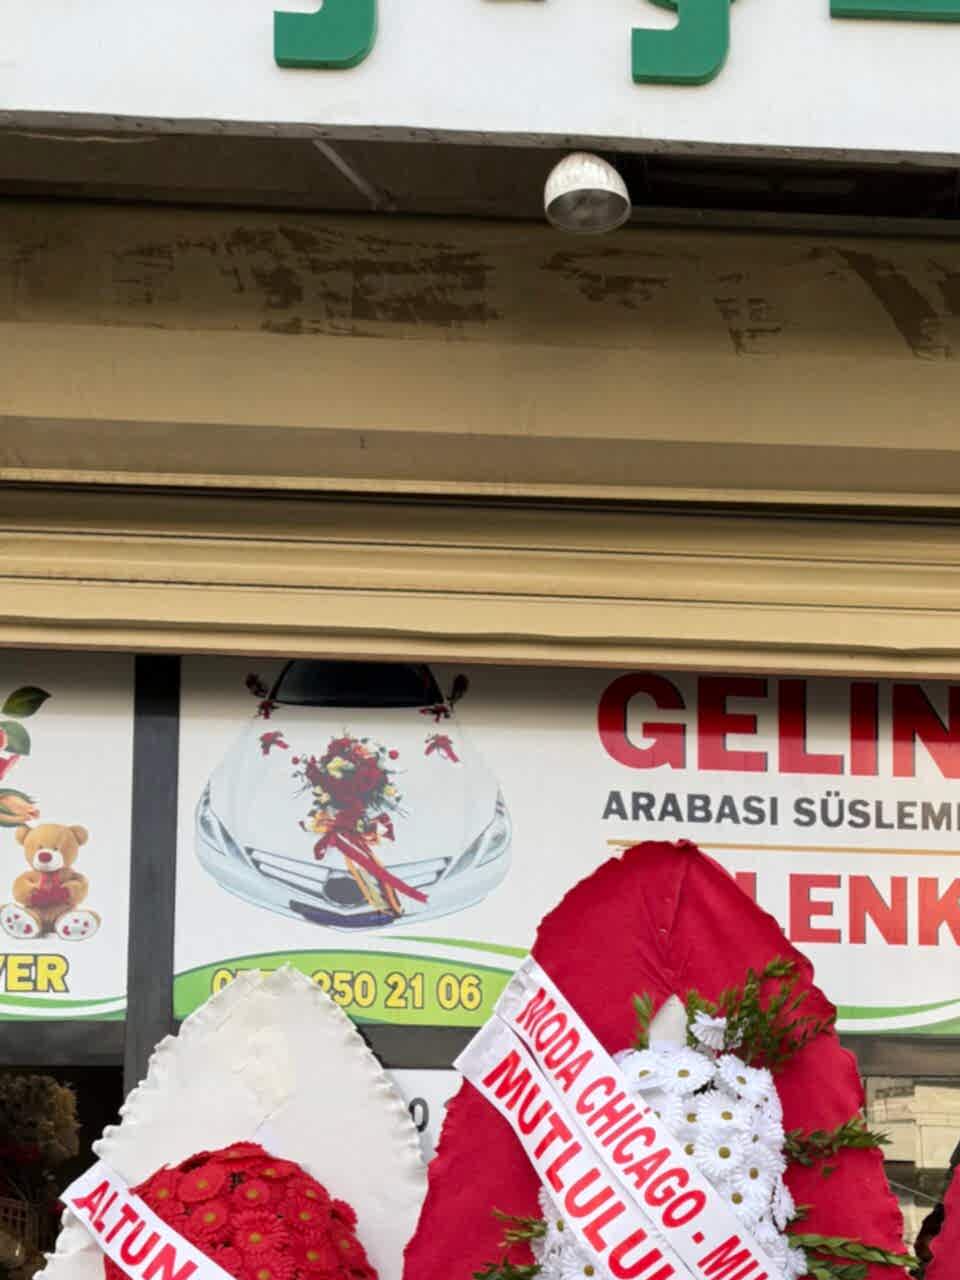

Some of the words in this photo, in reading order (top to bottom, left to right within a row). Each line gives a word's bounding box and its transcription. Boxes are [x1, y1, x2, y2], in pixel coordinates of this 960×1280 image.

[601, 790, 778, 826] ARABASI
[384, 972, 424, 1009] 21
[436, 973, 482, 1011] 06
[515, 987, 594, 1093] MODA
